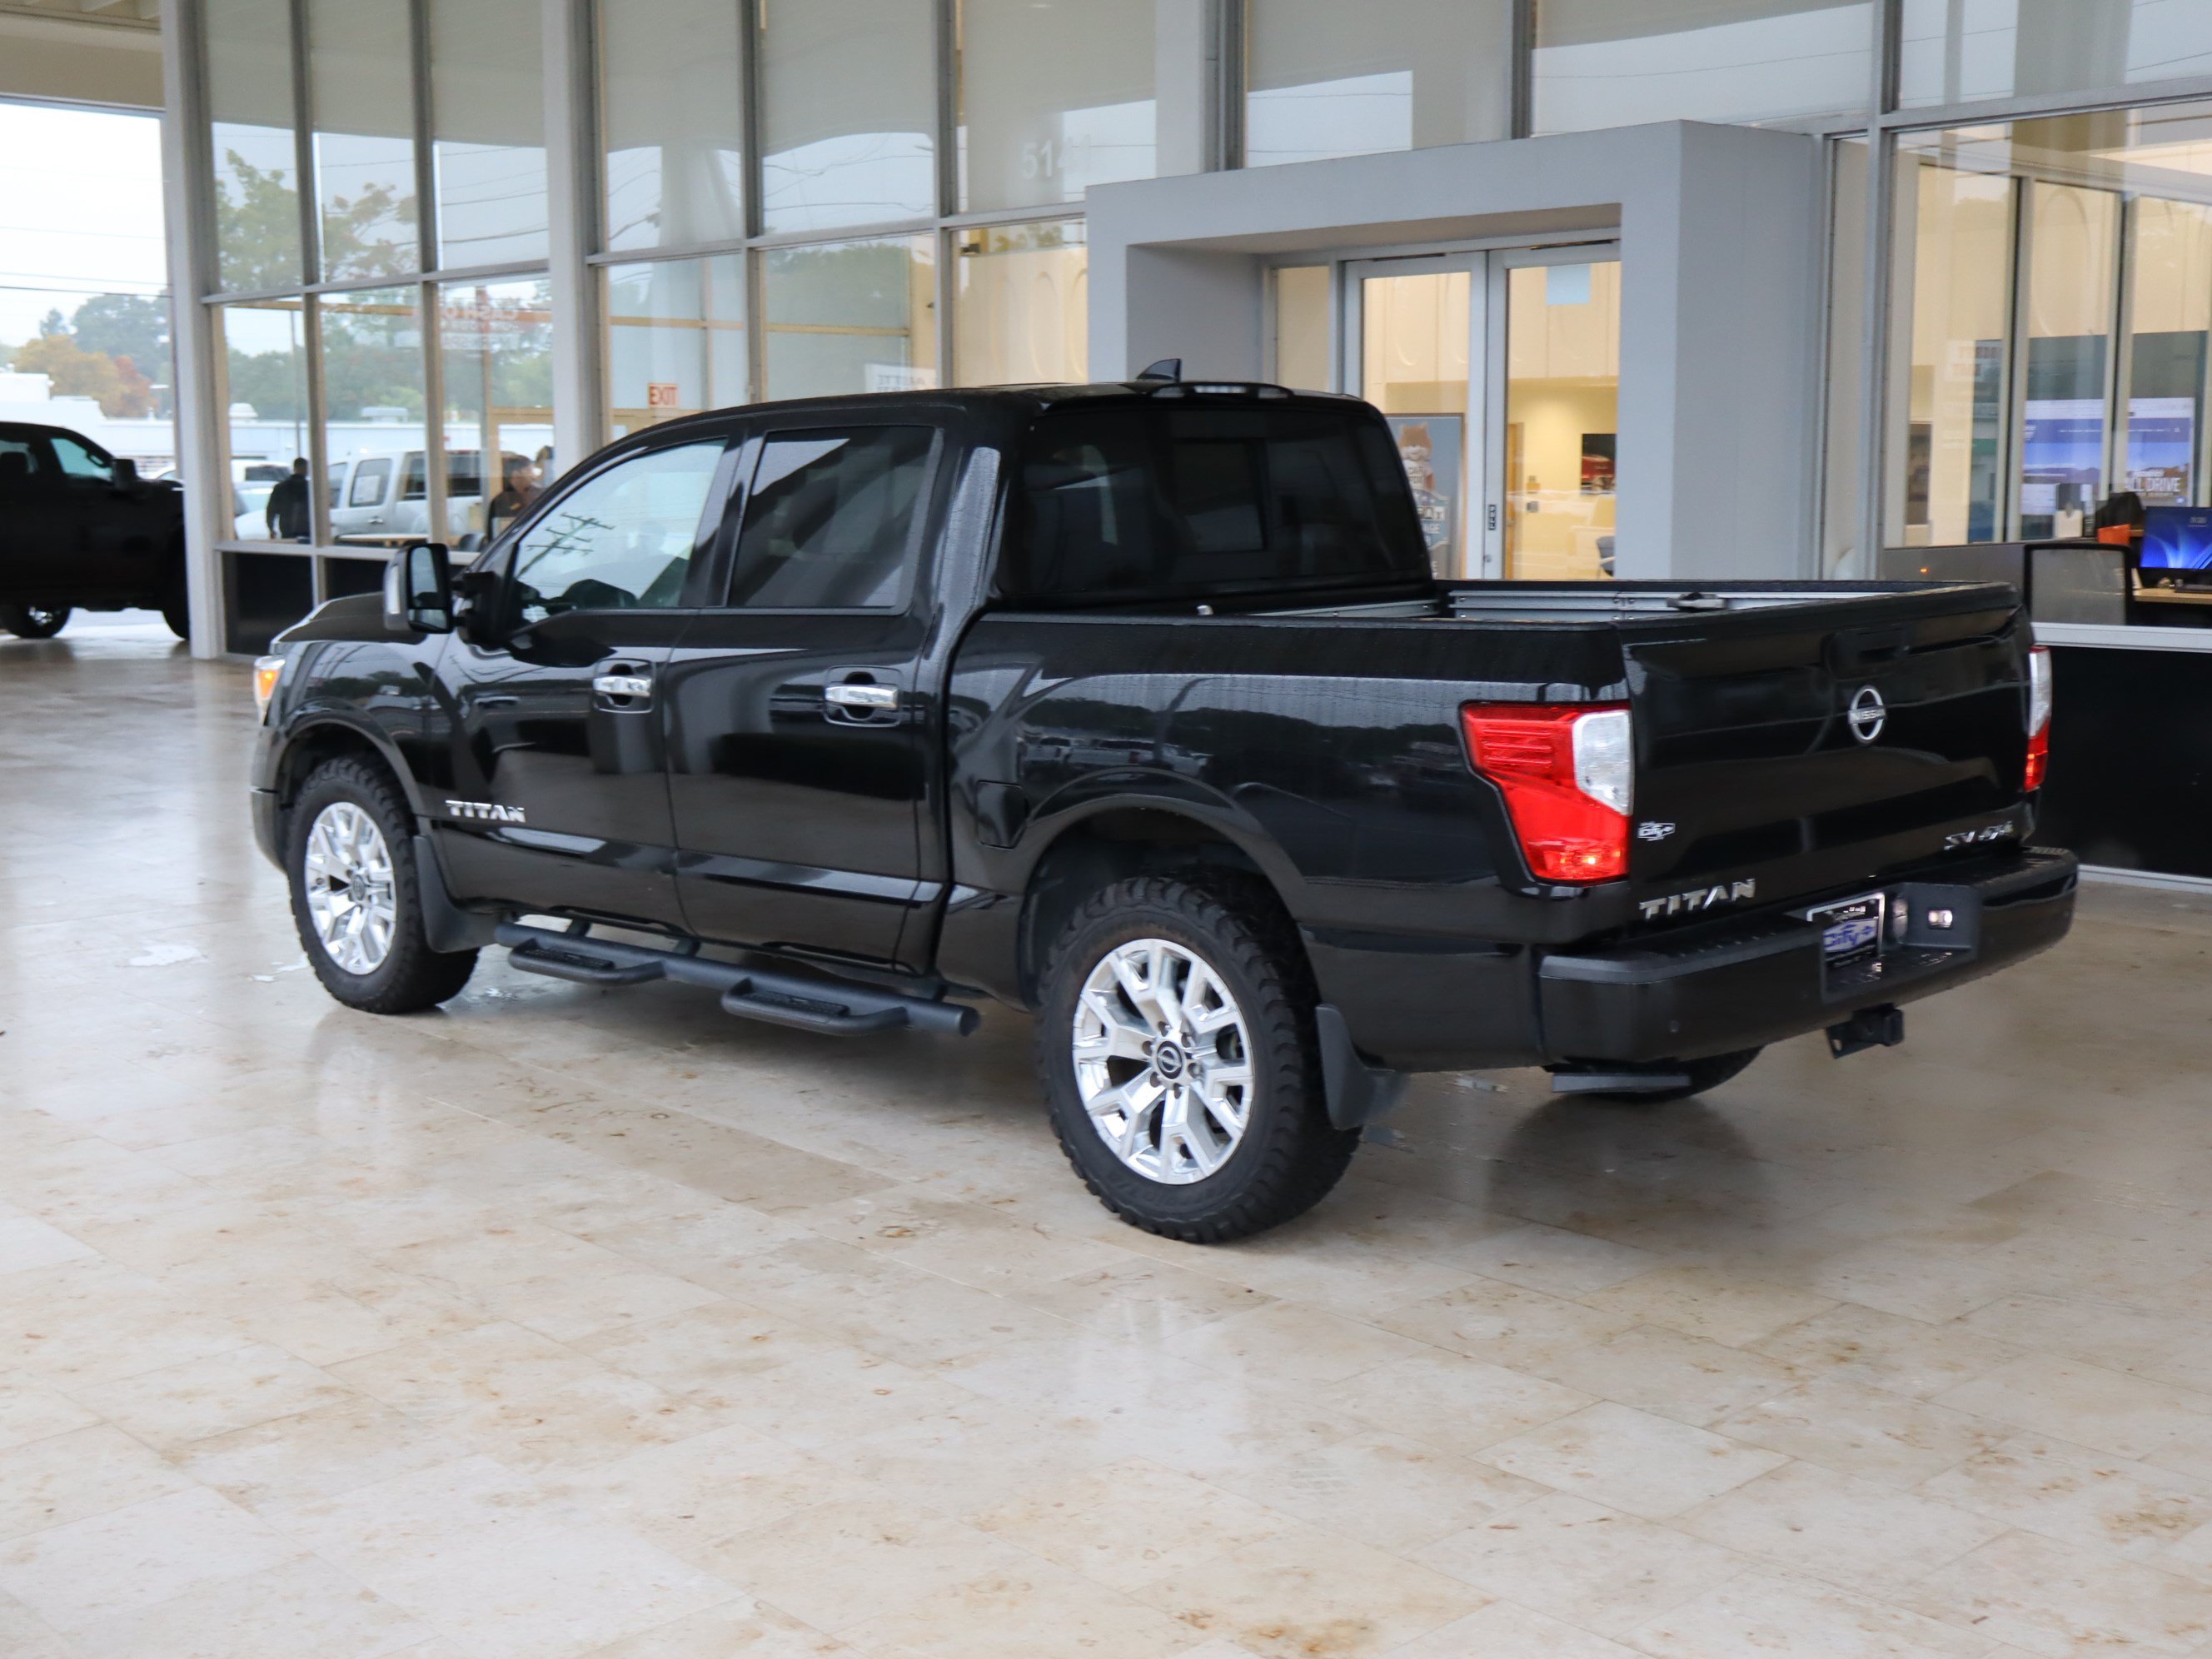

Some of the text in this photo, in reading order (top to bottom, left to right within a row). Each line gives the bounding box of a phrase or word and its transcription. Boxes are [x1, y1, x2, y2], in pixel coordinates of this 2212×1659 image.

[650, 386, 678, 406] EXIT
[2145, 476, 2181, 492] DRIVE
[445, 800, 526, 823] TITAN
[1944, 830, 1975, 850] SV
[1639, 878, 1756, 919] TITAN
[1824, 923, 1858, 948] City
